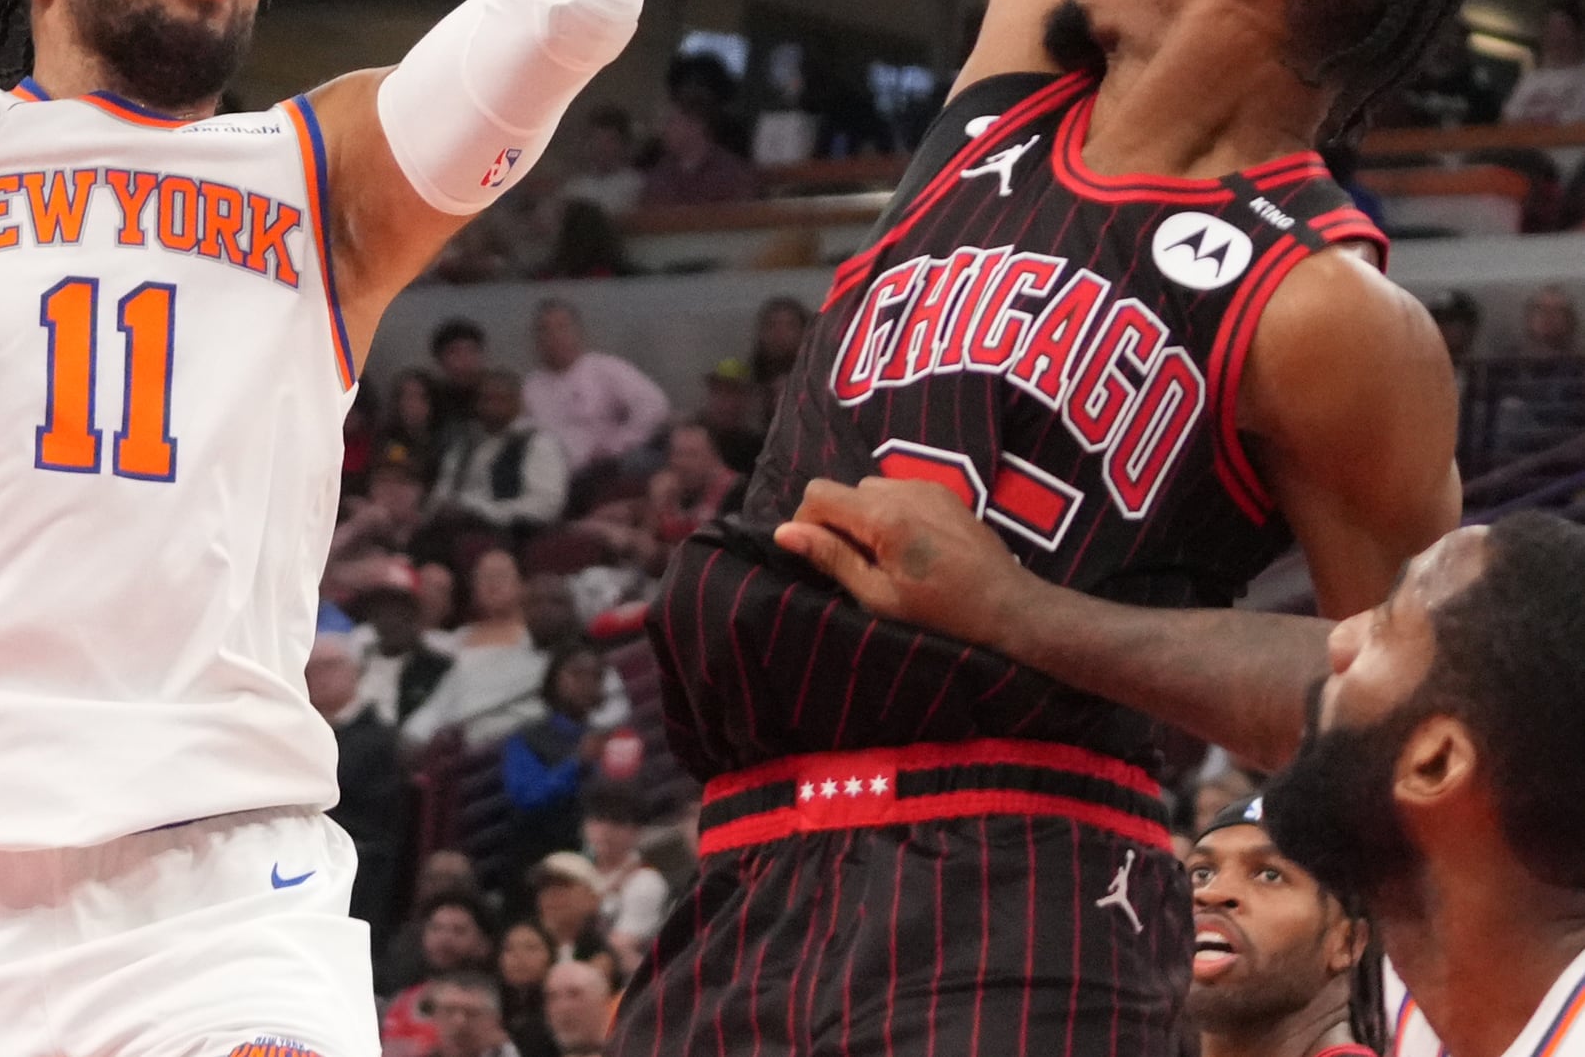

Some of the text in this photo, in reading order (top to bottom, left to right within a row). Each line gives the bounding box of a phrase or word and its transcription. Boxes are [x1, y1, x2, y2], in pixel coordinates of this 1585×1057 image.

[105, 167, 304, 291] YORK
[34, 275, 177, 483] 11
[830, 244, 1206, 520] CHICAGO
